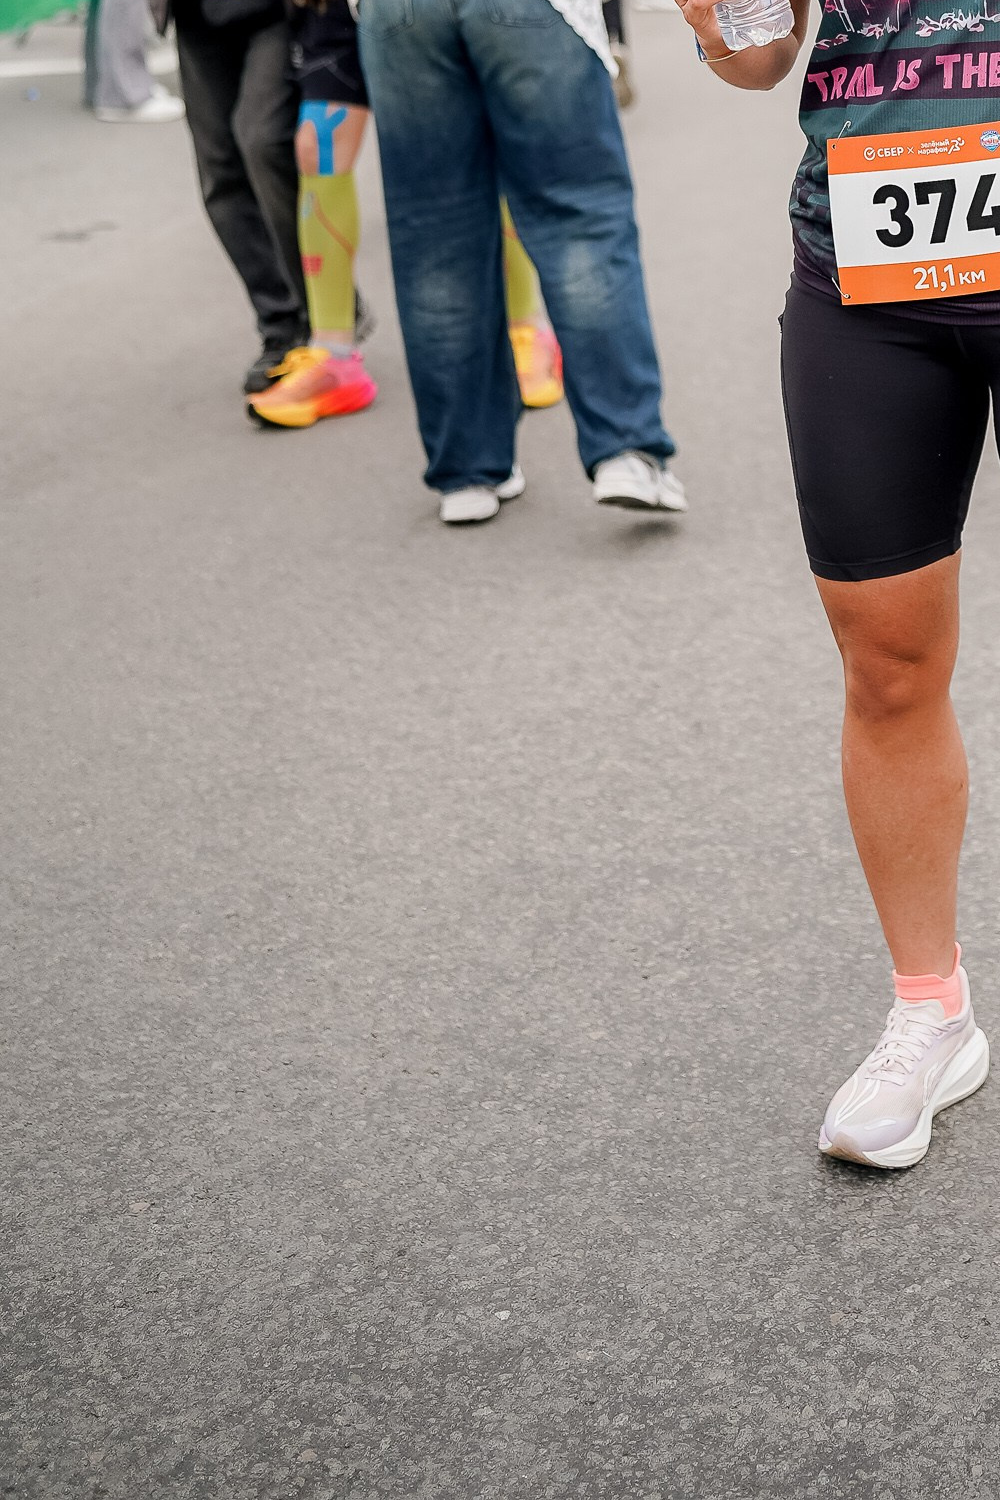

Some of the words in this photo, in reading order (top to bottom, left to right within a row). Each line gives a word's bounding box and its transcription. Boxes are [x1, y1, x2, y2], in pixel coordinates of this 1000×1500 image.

[807, 63, 884, 101] TRAIL
[891, 59, 922, 92] IS
[877, 146, 904, 158] СБЕР
